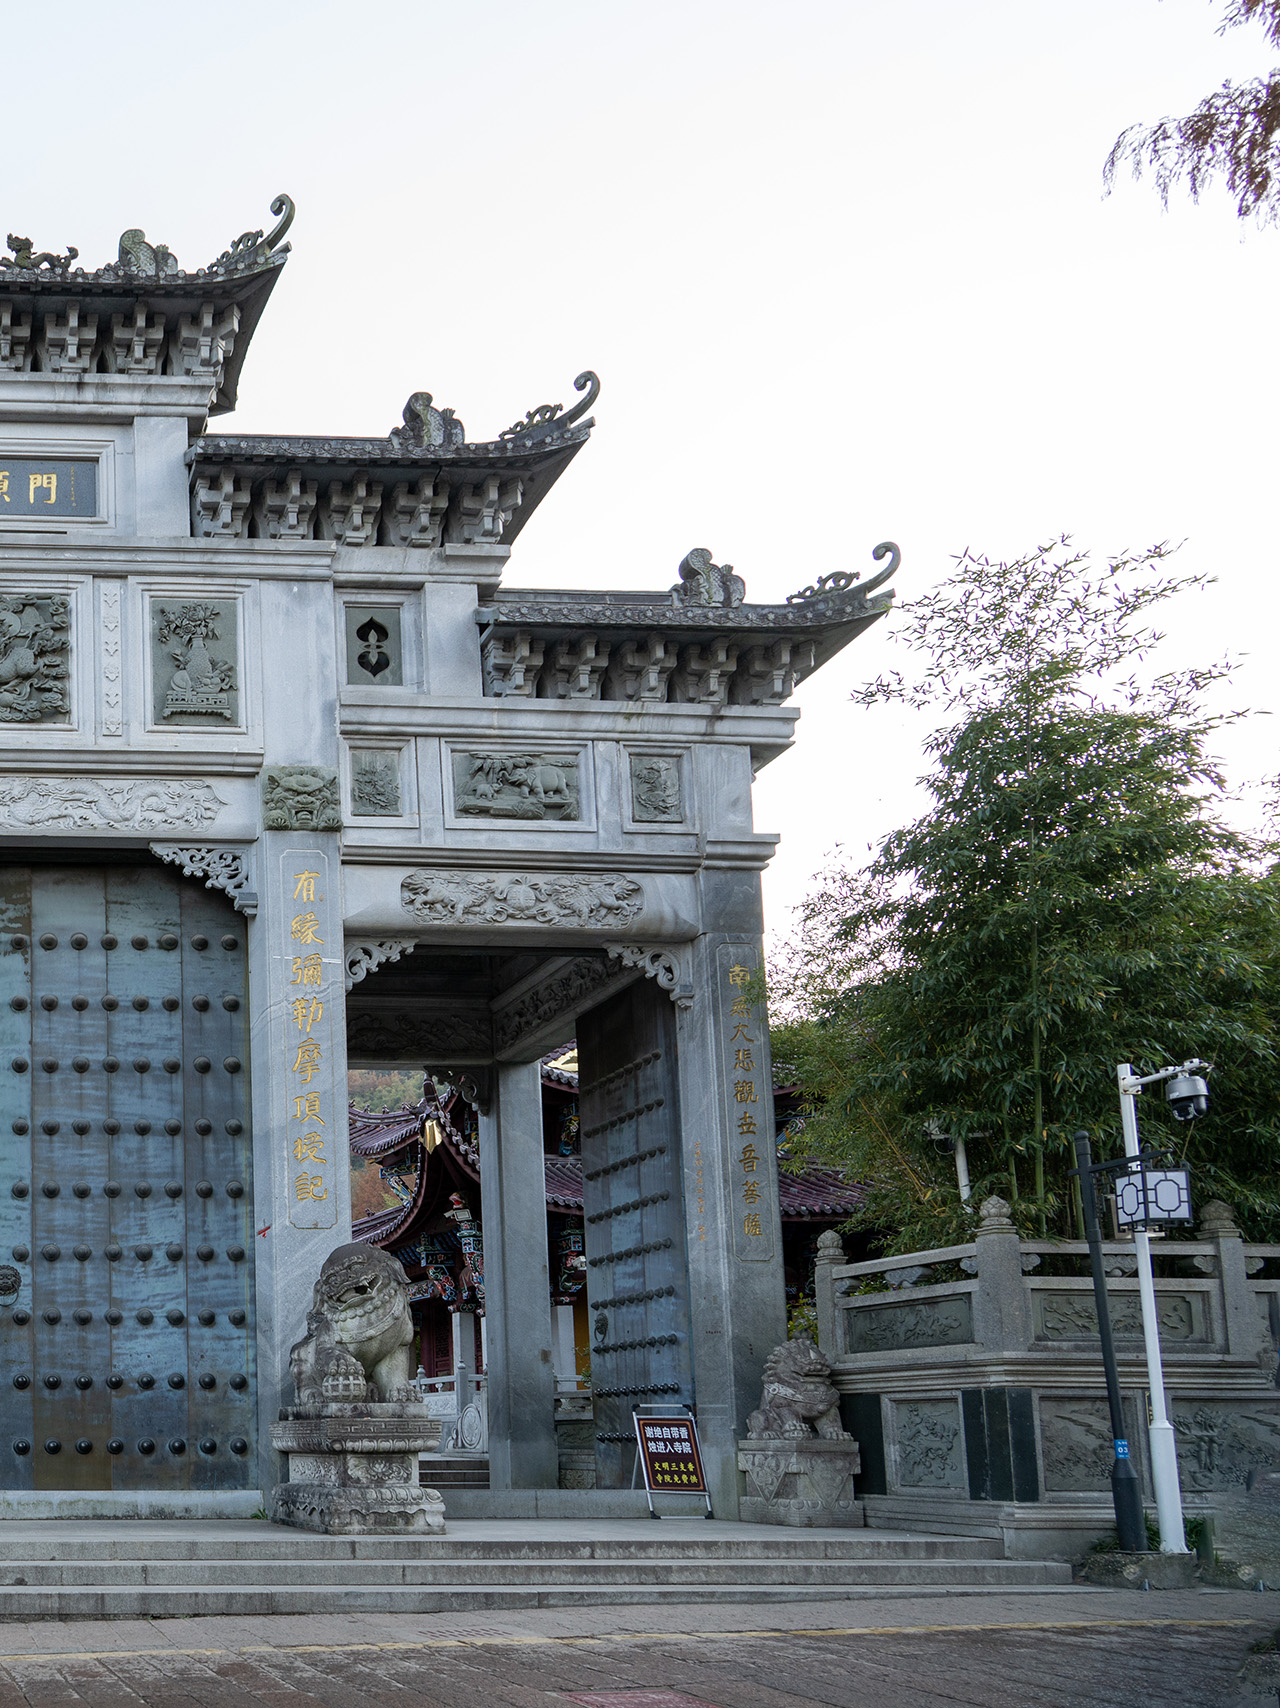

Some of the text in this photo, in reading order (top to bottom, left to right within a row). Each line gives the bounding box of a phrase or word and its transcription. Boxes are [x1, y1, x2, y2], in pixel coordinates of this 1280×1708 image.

[290, 869, 328, 1202] 有緣彌勒摩頂授記
[644, 1426, 688, 1438] 谢绝自带香
[648, 1441, 691, 1453] 烛进入寺院
[654, 1461, 695, 1472] 文明三支香
